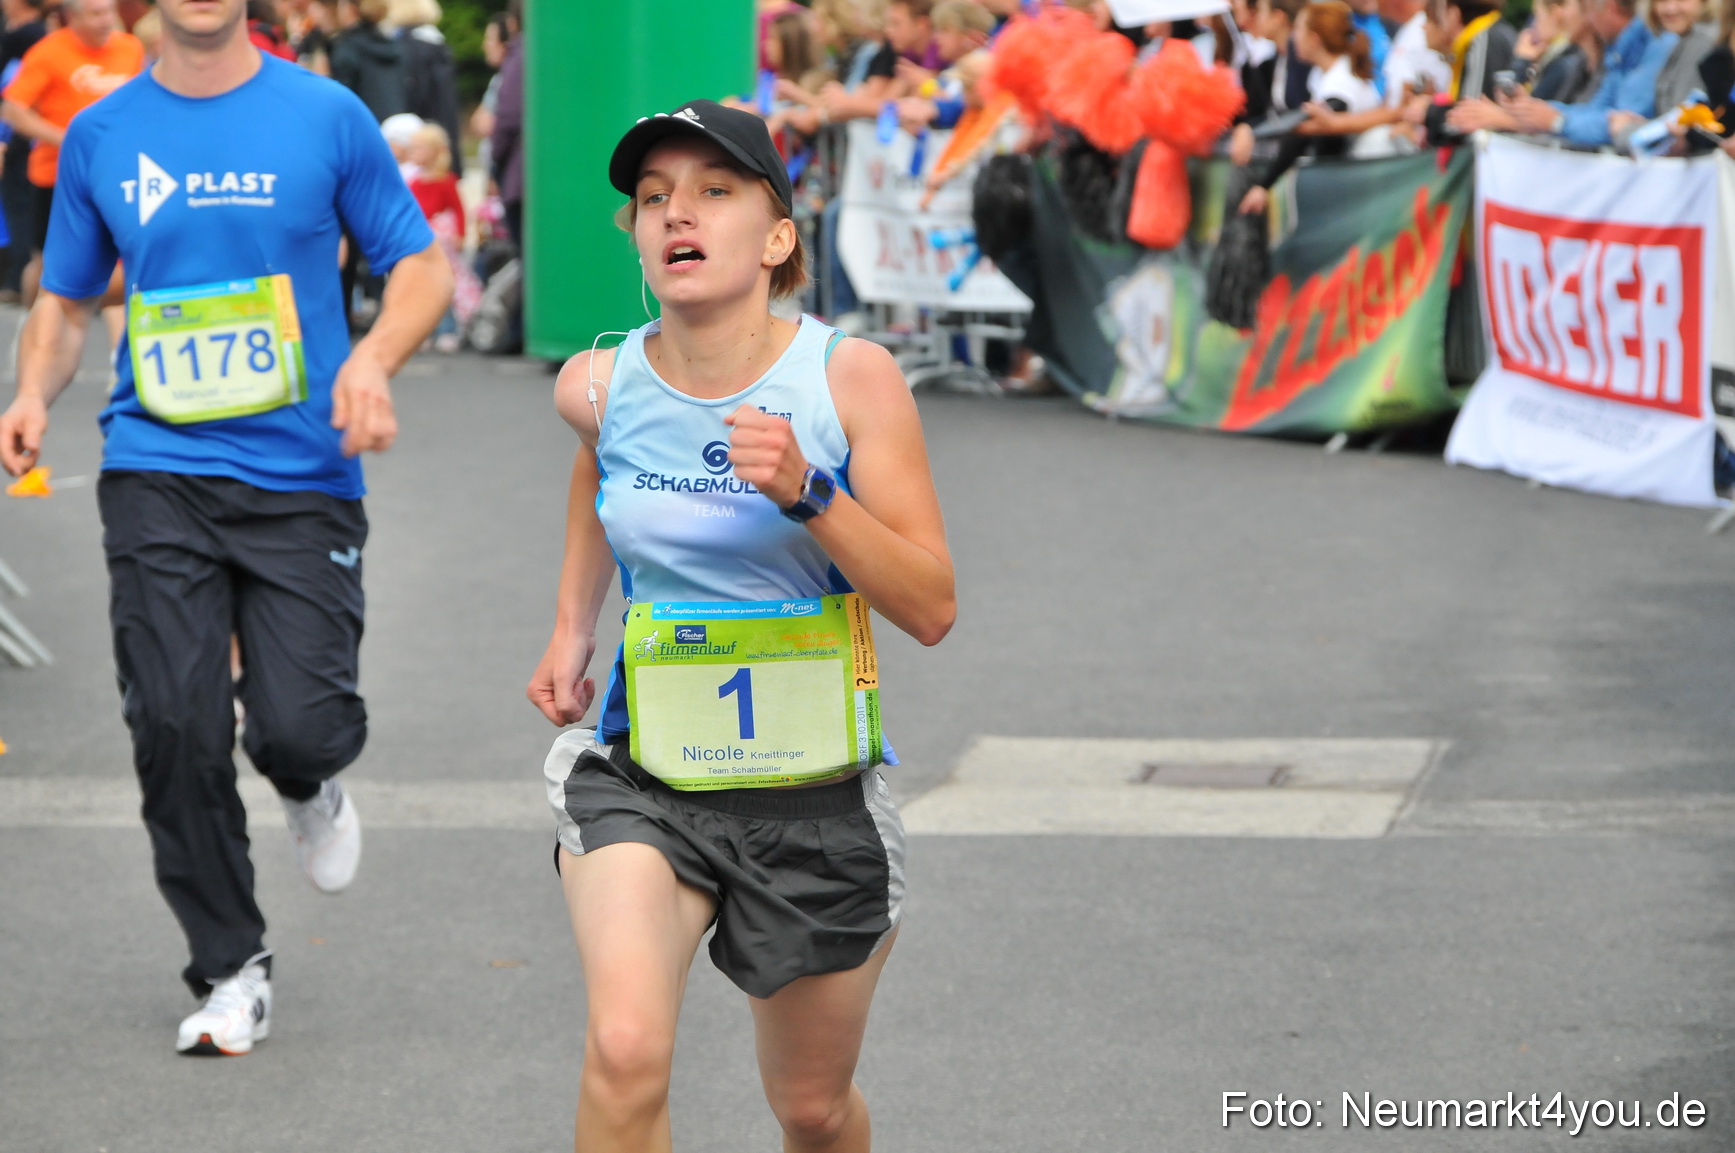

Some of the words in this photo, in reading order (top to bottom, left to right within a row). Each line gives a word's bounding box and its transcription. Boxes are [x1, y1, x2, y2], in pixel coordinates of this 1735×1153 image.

[186, 171, 277, 194] PLAST
[1489, 221, 1684, 403] MEIER
[143, 328, 275, 386] 1178
[633, 473, 764, 494] SCHABMÜL
[693, 504, 736, 518] TEAM
[780, 602, 816, 615] M-net
[660, 641, 737, 656] firmenlauf
[718, 668, 755, 740] 1
[683, 745, 745, 761] Nicole
[750, 750, 805, 760] Kneittinger
[731, 766, 782, 774] Schabmüller
